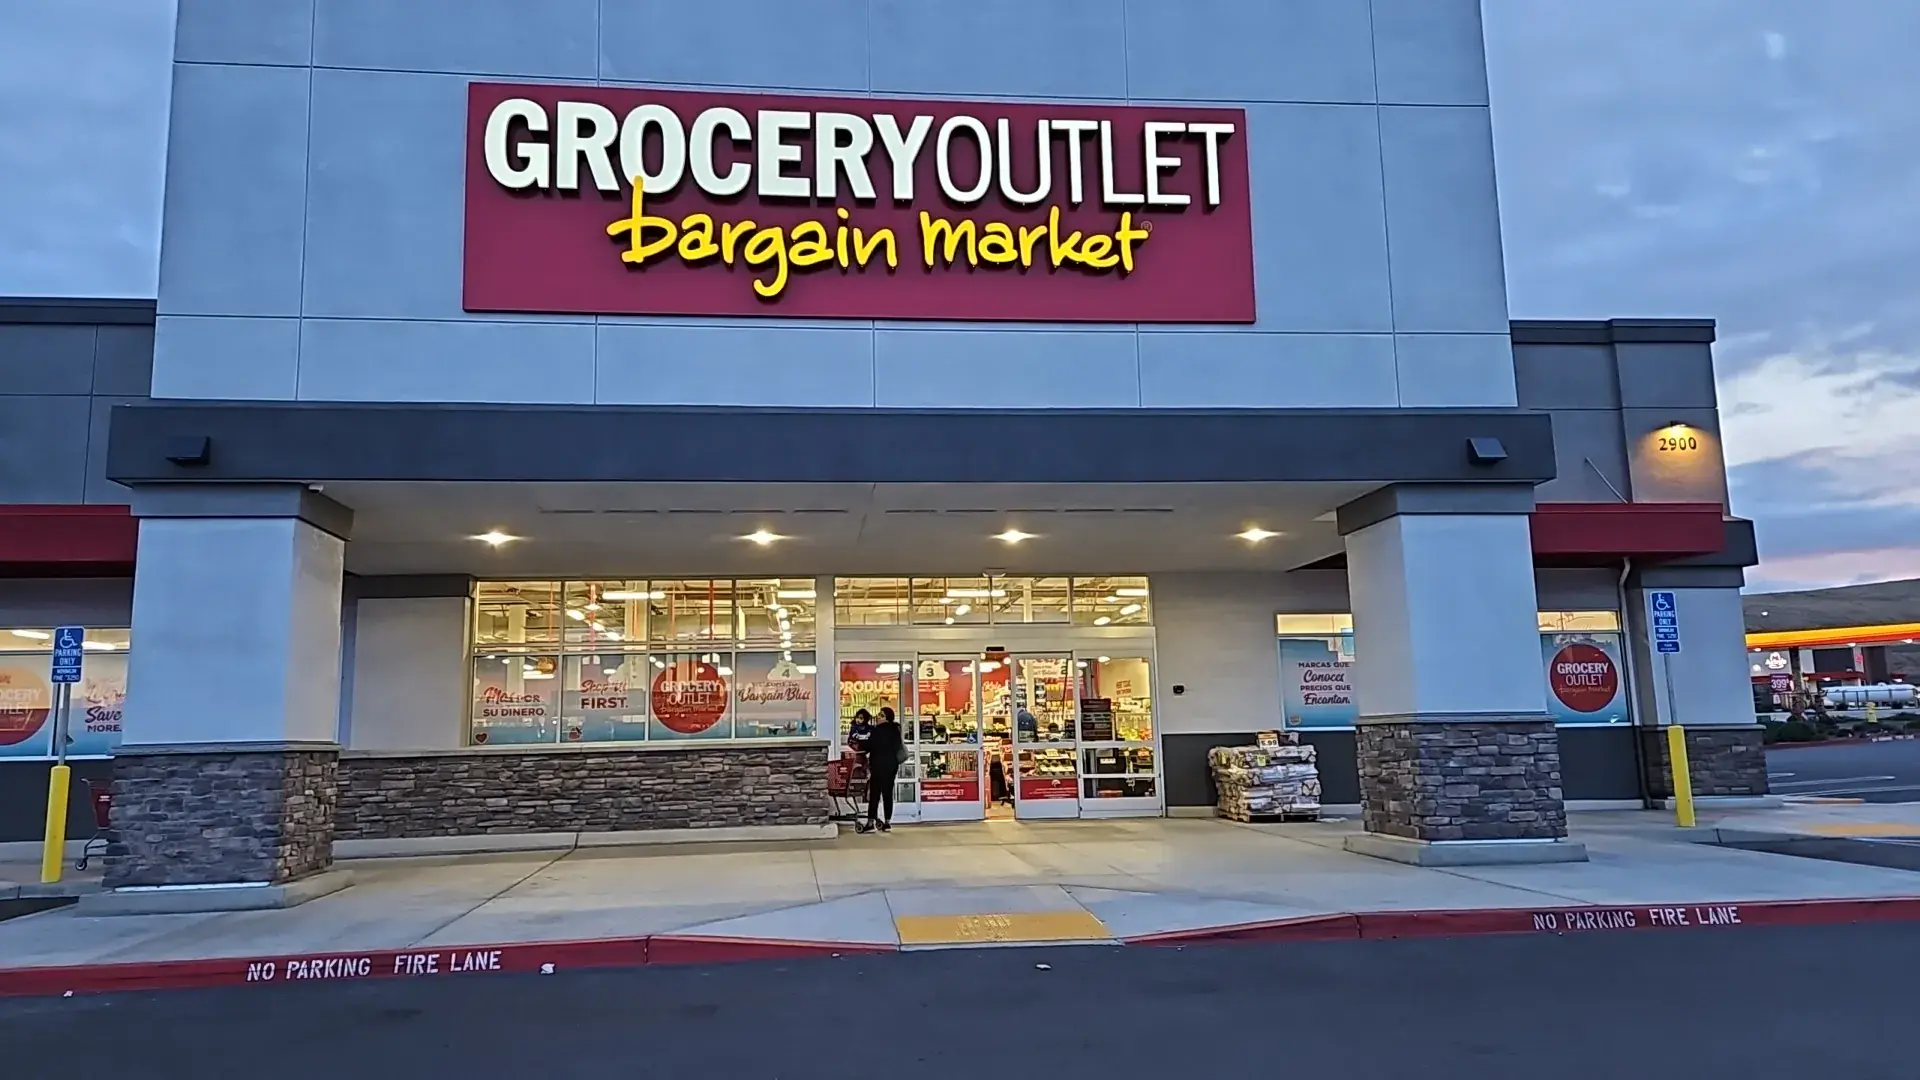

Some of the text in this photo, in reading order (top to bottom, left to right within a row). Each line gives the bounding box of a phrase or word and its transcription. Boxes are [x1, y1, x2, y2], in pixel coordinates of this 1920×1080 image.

[606, 176, 1150, 299] bargain market
[1658, 436, 1697, 451] 2900
[55, 648, 82, 657] PARKING
[59, 657, 76, 666] ONLY
[1557, 662, 1609, 674] GROCERY
[781, 668, 791, 679] 4
[926, 667, 935, 678] 3
[660, 680, 719, 693] GROCERY
[840, 680, 899, 693] PRODUCE
[1565, 674, 1603, 686] OUTLET
[581, 696, 629, 709] FIRST.
[667, 692, 711, 705] OUTLET
[85, 706, 123, 723] Save
[483, 707, 548, 717] SU DINERO.
[1533, 906, 1742, 930] NO PARKING FIRE LANE
[246, 950, 502, 981] NO PARKING FIRE LANE
